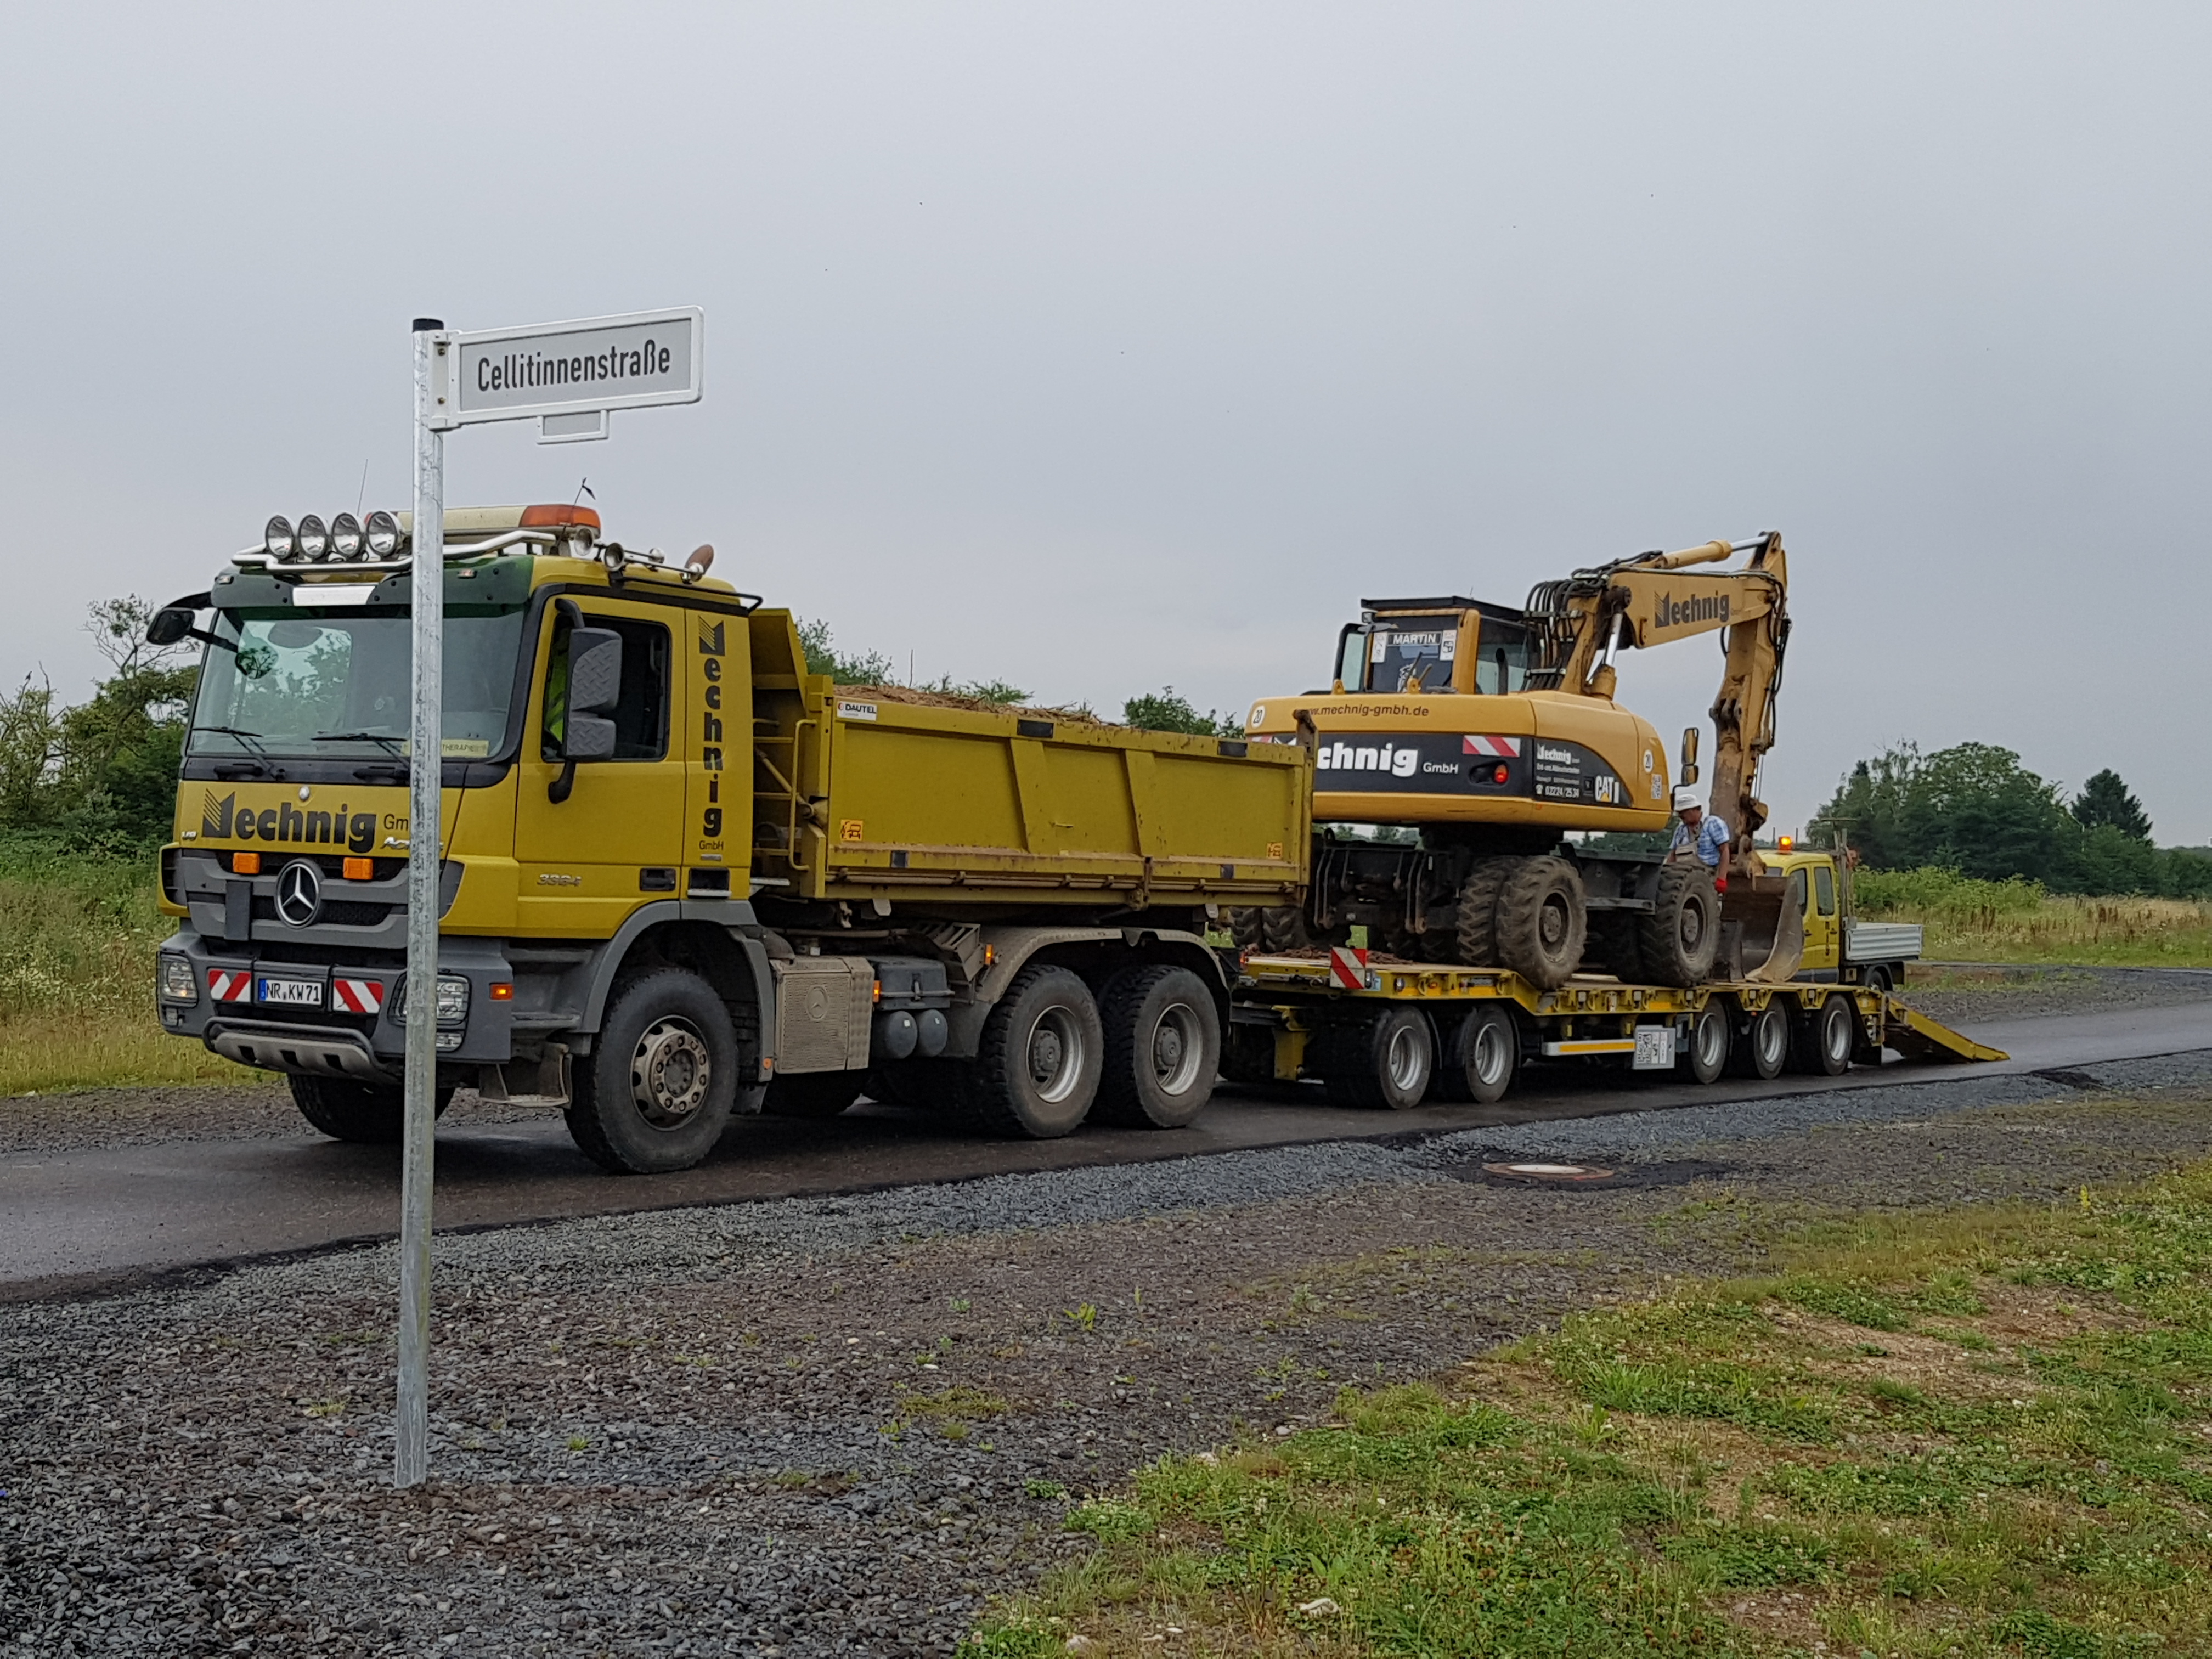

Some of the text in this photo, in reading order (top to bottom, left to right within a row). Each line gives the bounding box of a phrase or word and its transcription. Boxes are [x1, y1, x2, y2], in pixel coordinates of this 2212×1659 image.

[477, 339, 670, 392] Cellitinnenstraße
[1392, 634, 1437, 644] MARTIN
[845, 704, 877, 714] DAUTEL
[1274, 737, 1459, 777] chnig GmbH
[1595, 775, 1614, 802] CAT
[384, 814, 409, 831] Gm
[699, 840, 724, 850] GmbH
